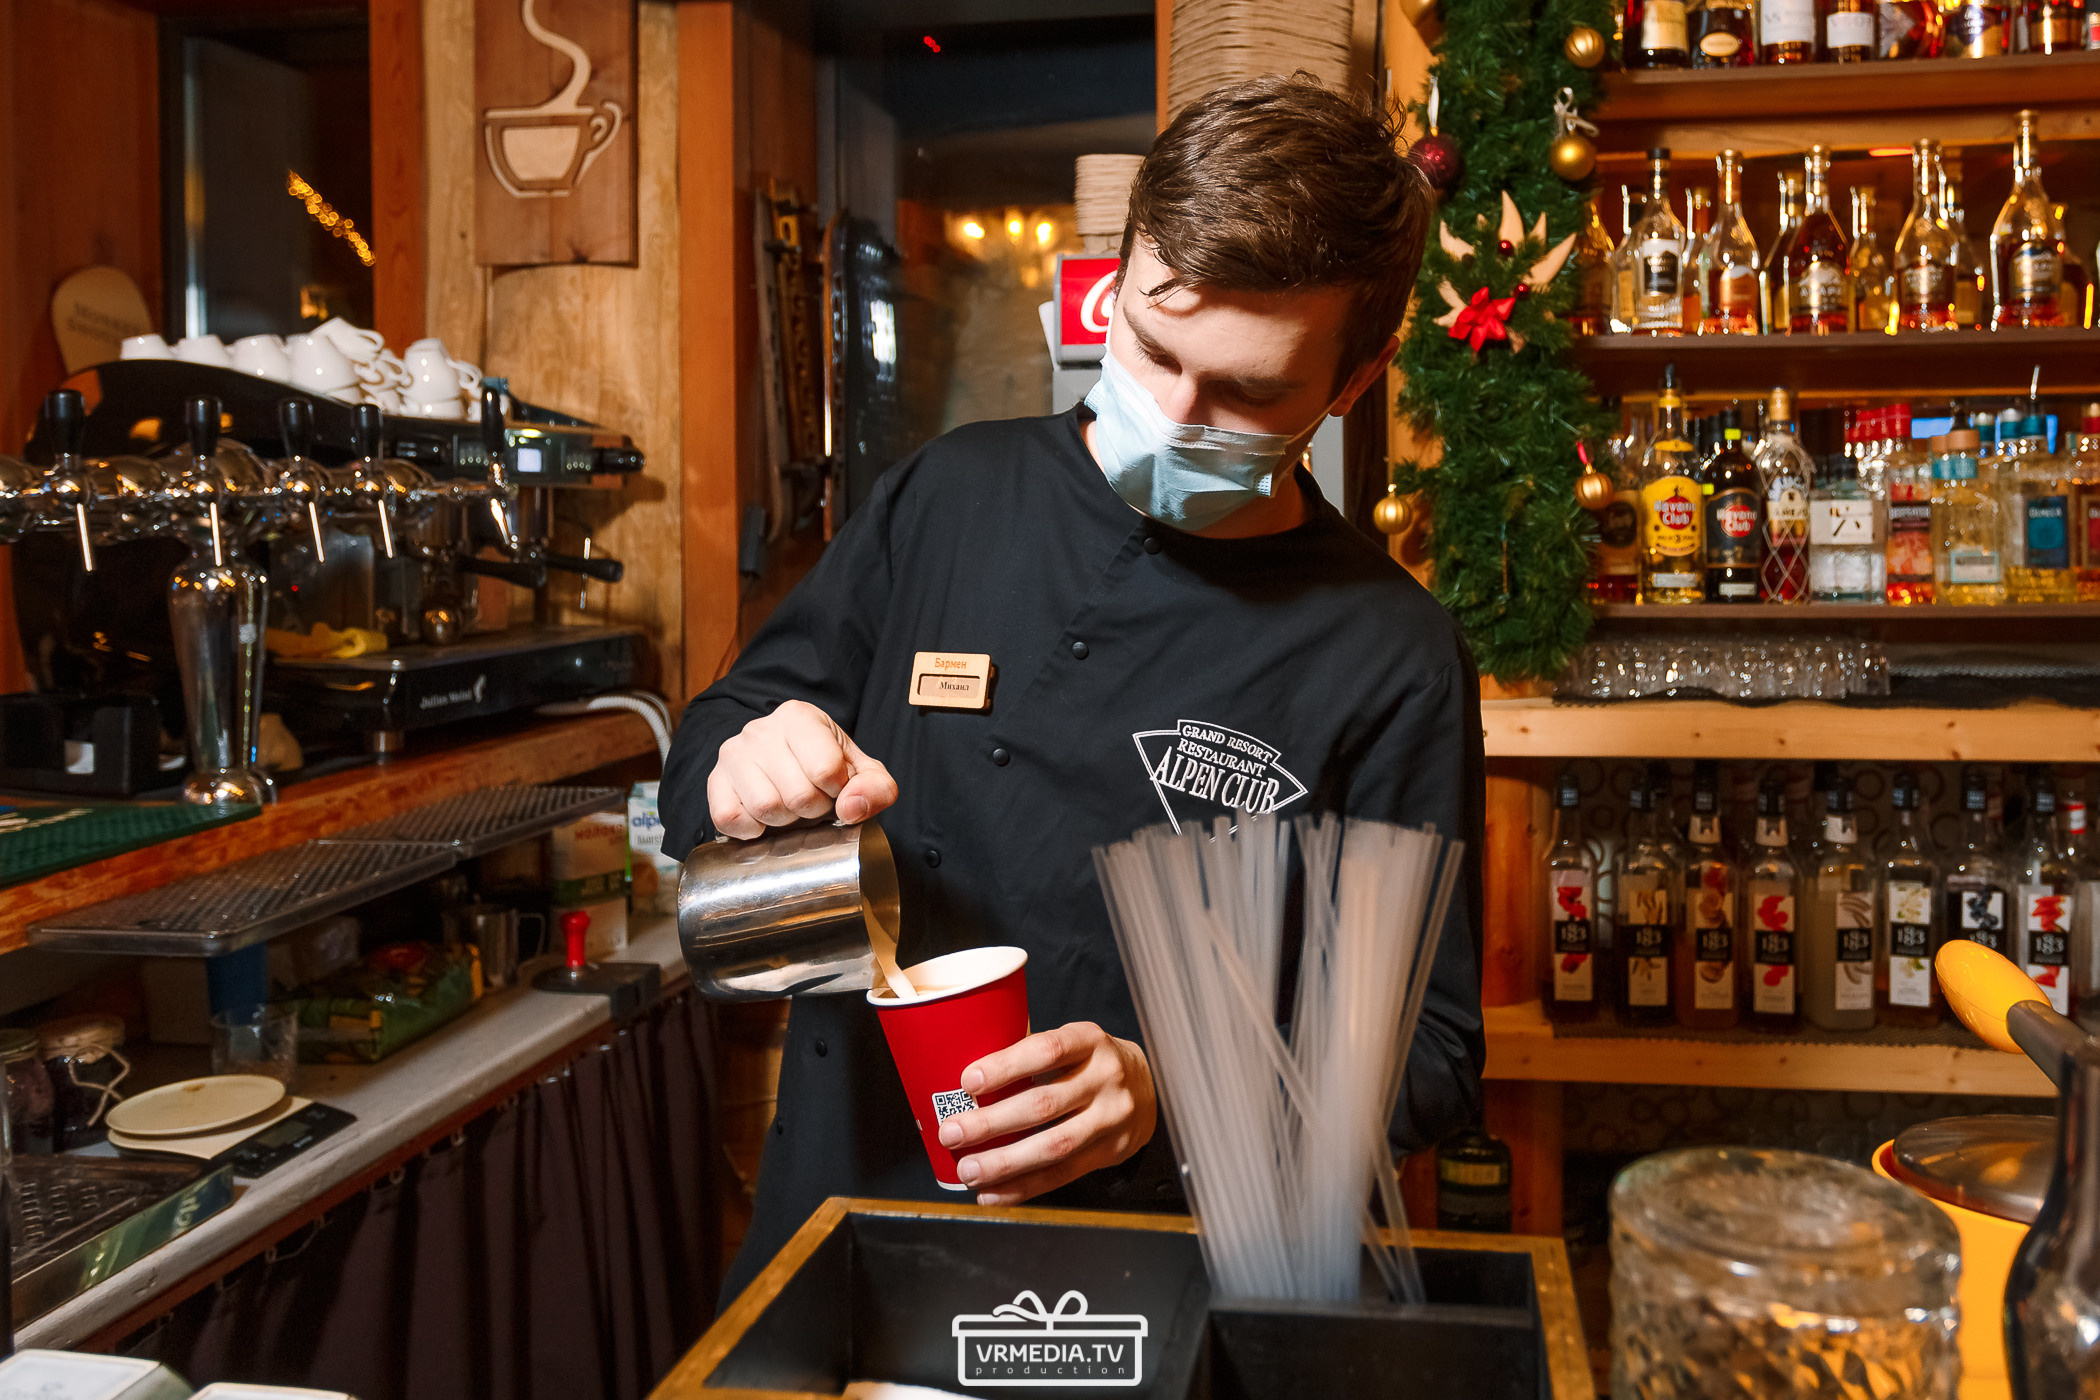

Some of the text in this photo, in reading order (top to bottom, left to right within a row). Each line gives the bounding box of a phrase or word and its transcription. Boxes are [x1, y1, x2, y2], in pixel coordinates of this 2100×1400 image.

[1662, 511, 1690, 525] Club
[1725, 519, 1751, 532] Club
[934, 657, 967, 671] Бармен
[939, 681, 970, 691] Михаил
[1182, 724, 1274, 763] GRAND RESORT
[1176, 738, 1267, 778] RESTAURANT
[1149, 745, 1281, 815] ALPEN CLUB
